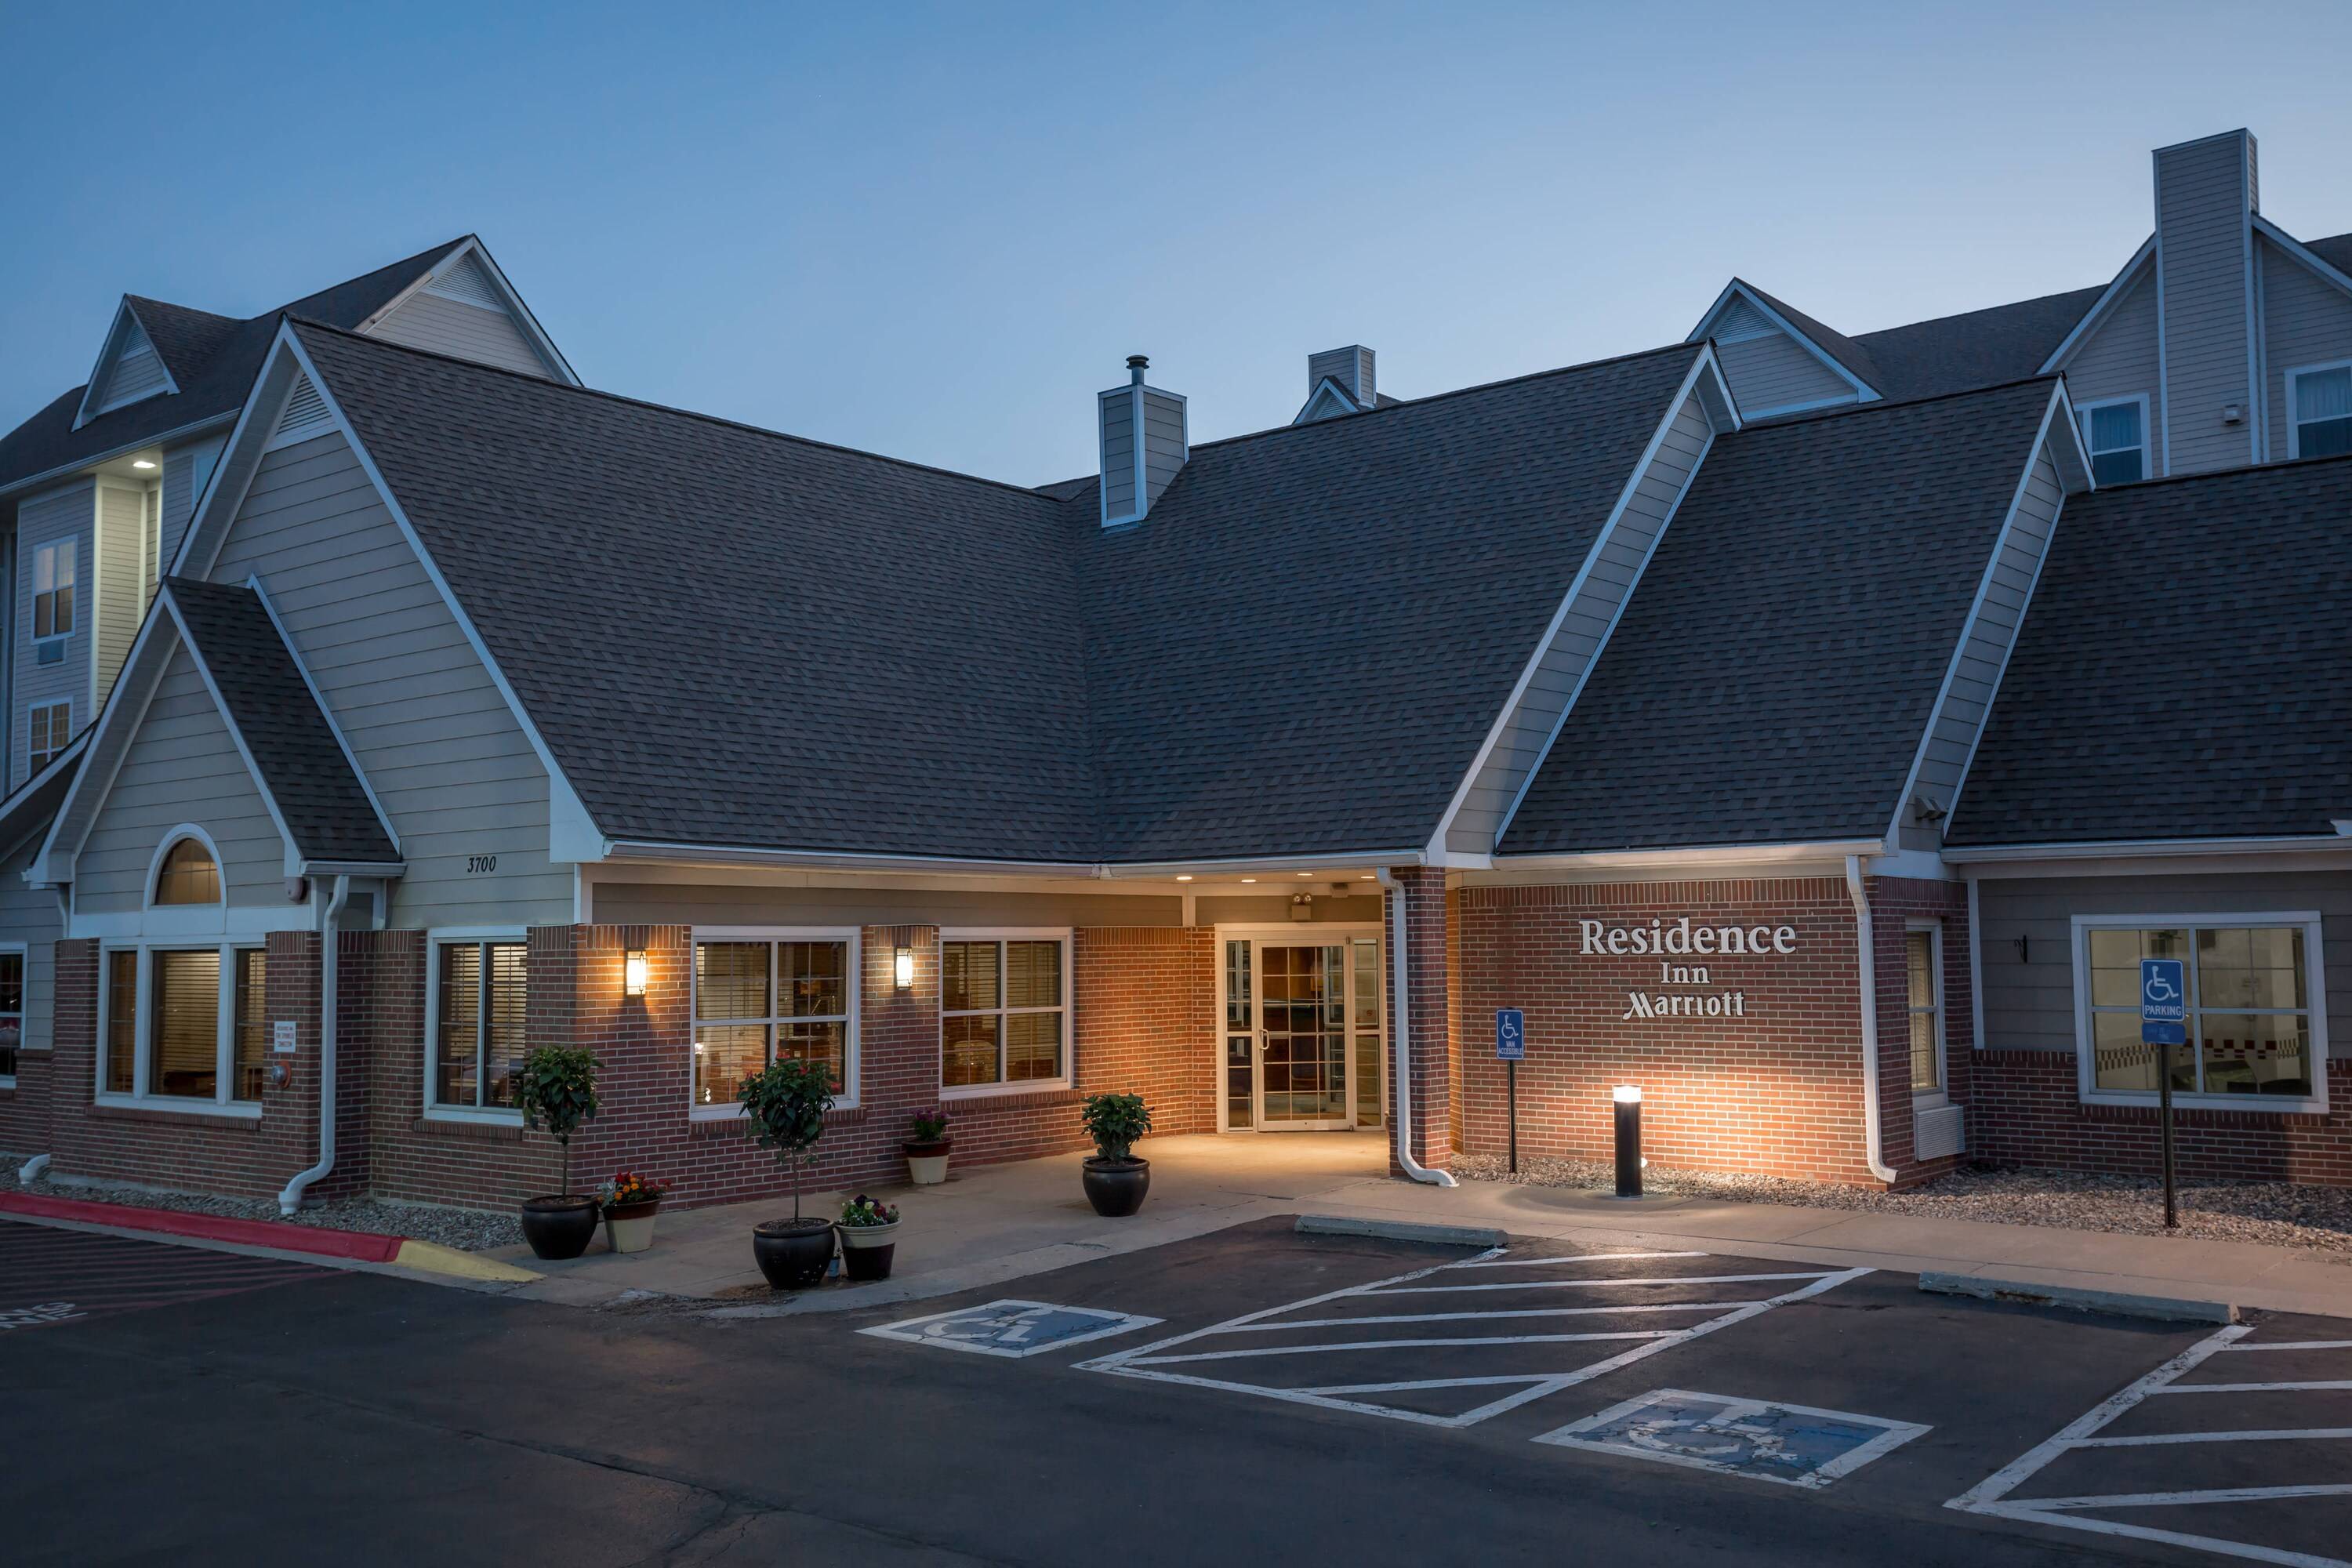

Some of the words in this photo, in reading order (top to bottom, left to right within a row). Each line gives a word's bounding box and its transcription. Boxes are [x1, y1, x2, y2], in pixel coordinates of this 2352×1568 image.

[467, 855, 496, 873] 3700
[1578, 916, 1797, 954] Residence
[1661, 962, 1711, 984] Inn
[1622, 991, 1744, 1020] Marriott
[2144, 1005, 2182, 1016] PARKING
